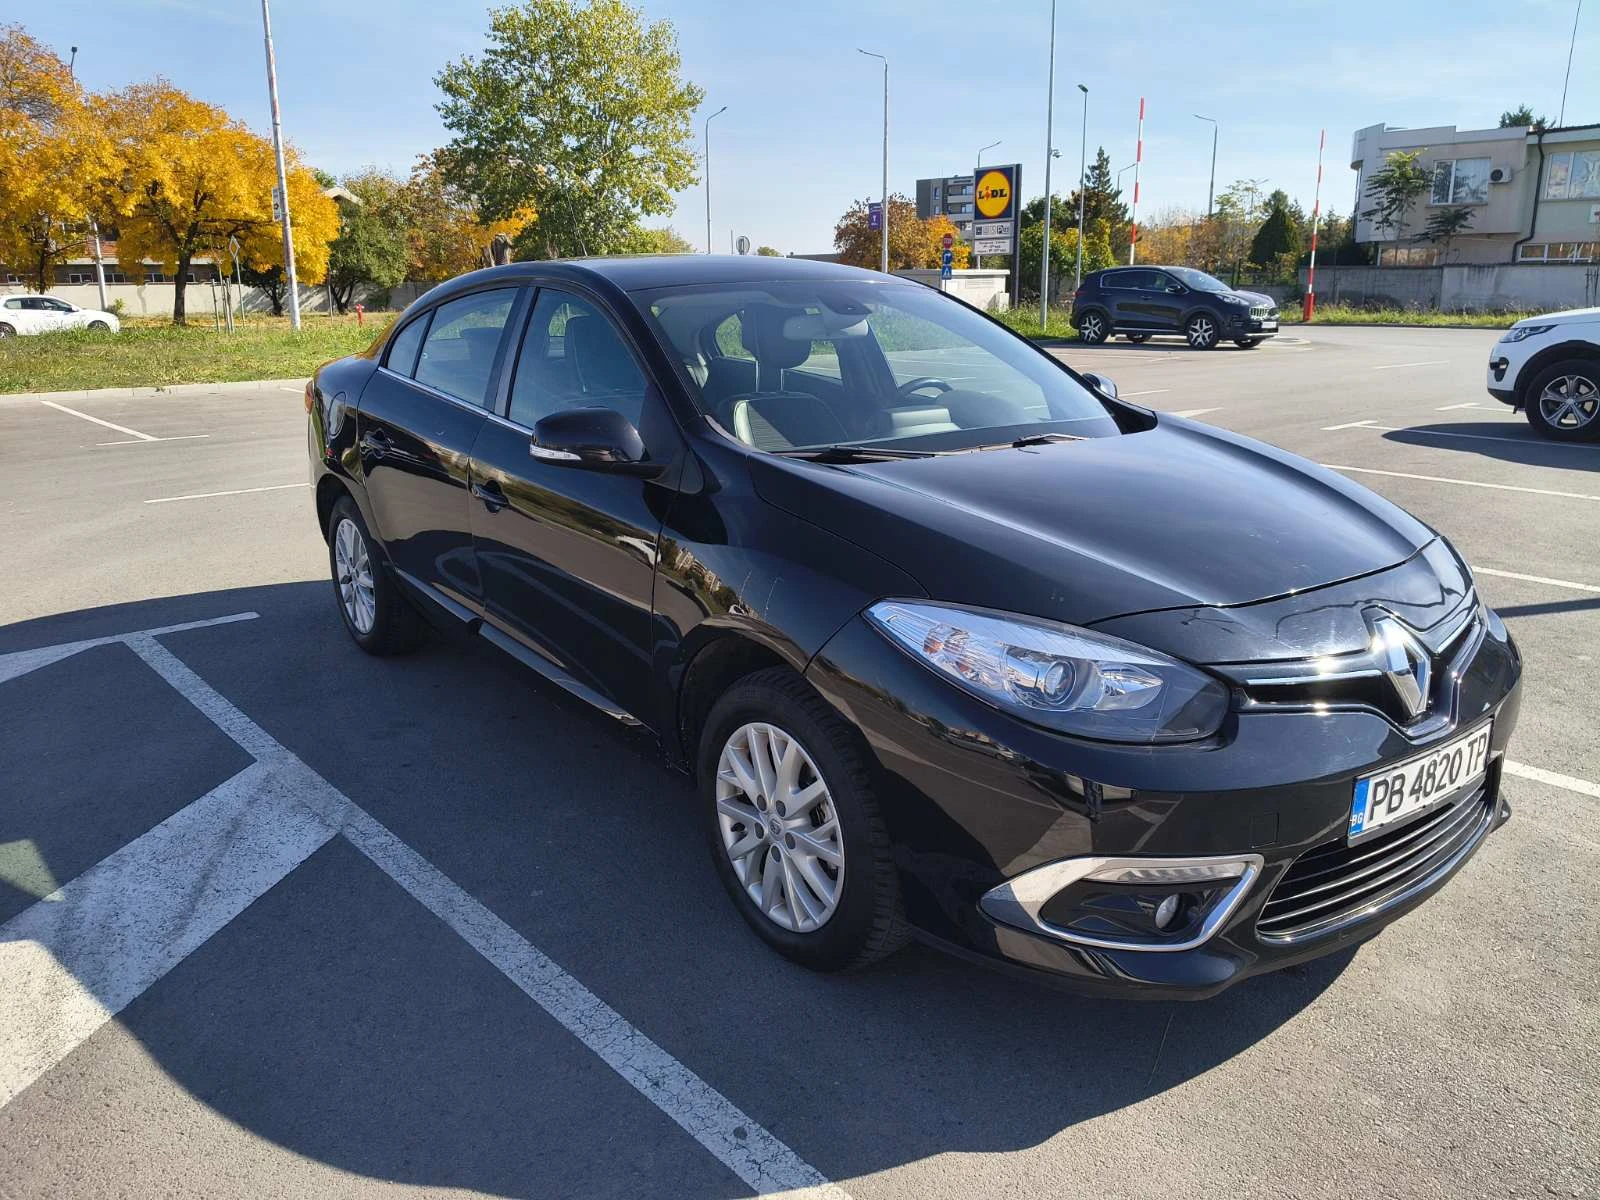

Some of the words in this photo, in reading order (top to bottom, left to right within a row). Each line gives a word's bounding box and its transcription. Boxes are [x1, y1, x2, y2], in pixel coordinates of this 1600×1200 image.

[1368, 773, 1405, 821] PB
[1410, 748, 1462, 803] 4820
[1466, 732, 1487, 776] TP
[1352, 812, 1363, 827] BG
